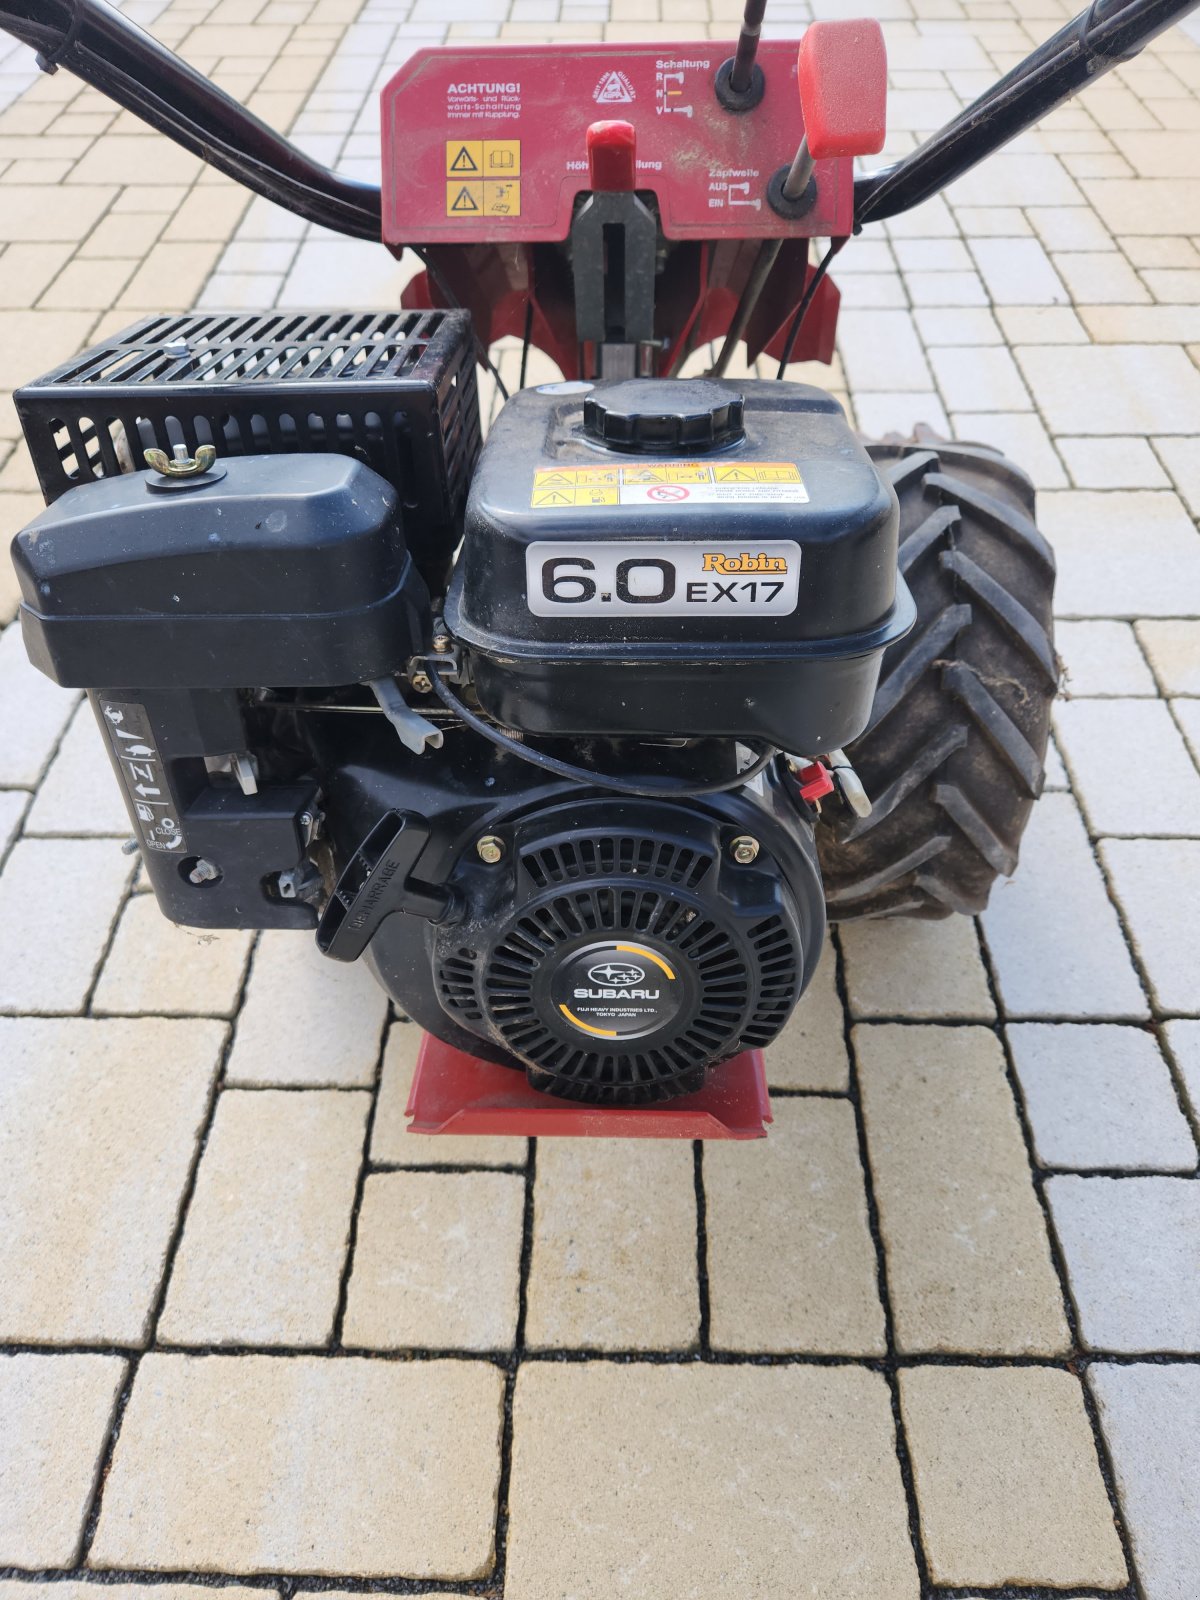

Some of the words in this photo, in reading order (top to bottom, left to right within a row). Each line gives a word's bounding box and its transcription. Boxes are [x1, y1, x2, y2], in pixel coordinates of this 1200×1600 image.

[656, 59, 710, 69] Schaltung
[655, 72, 663, 81] R
[447, 83, 521, 94] ACHTUNG!
[655, 89, 663, 98] N
[655, 106, 663, 115] V
[708, 168, 759, 178] Zapfwelle
[708, 183, 728, 191] AUS
[708, 199, 723, 207] EIN
[702, 552, 788, 575] Robin
[541, 557, 676, 604] 6.0
[686, 582, 785, 603] EX17
[155, 827, 181, 836] CLOSE
[146, 838, 167, 849] OPEN
[573, 988, 660, 999] SUBARU
